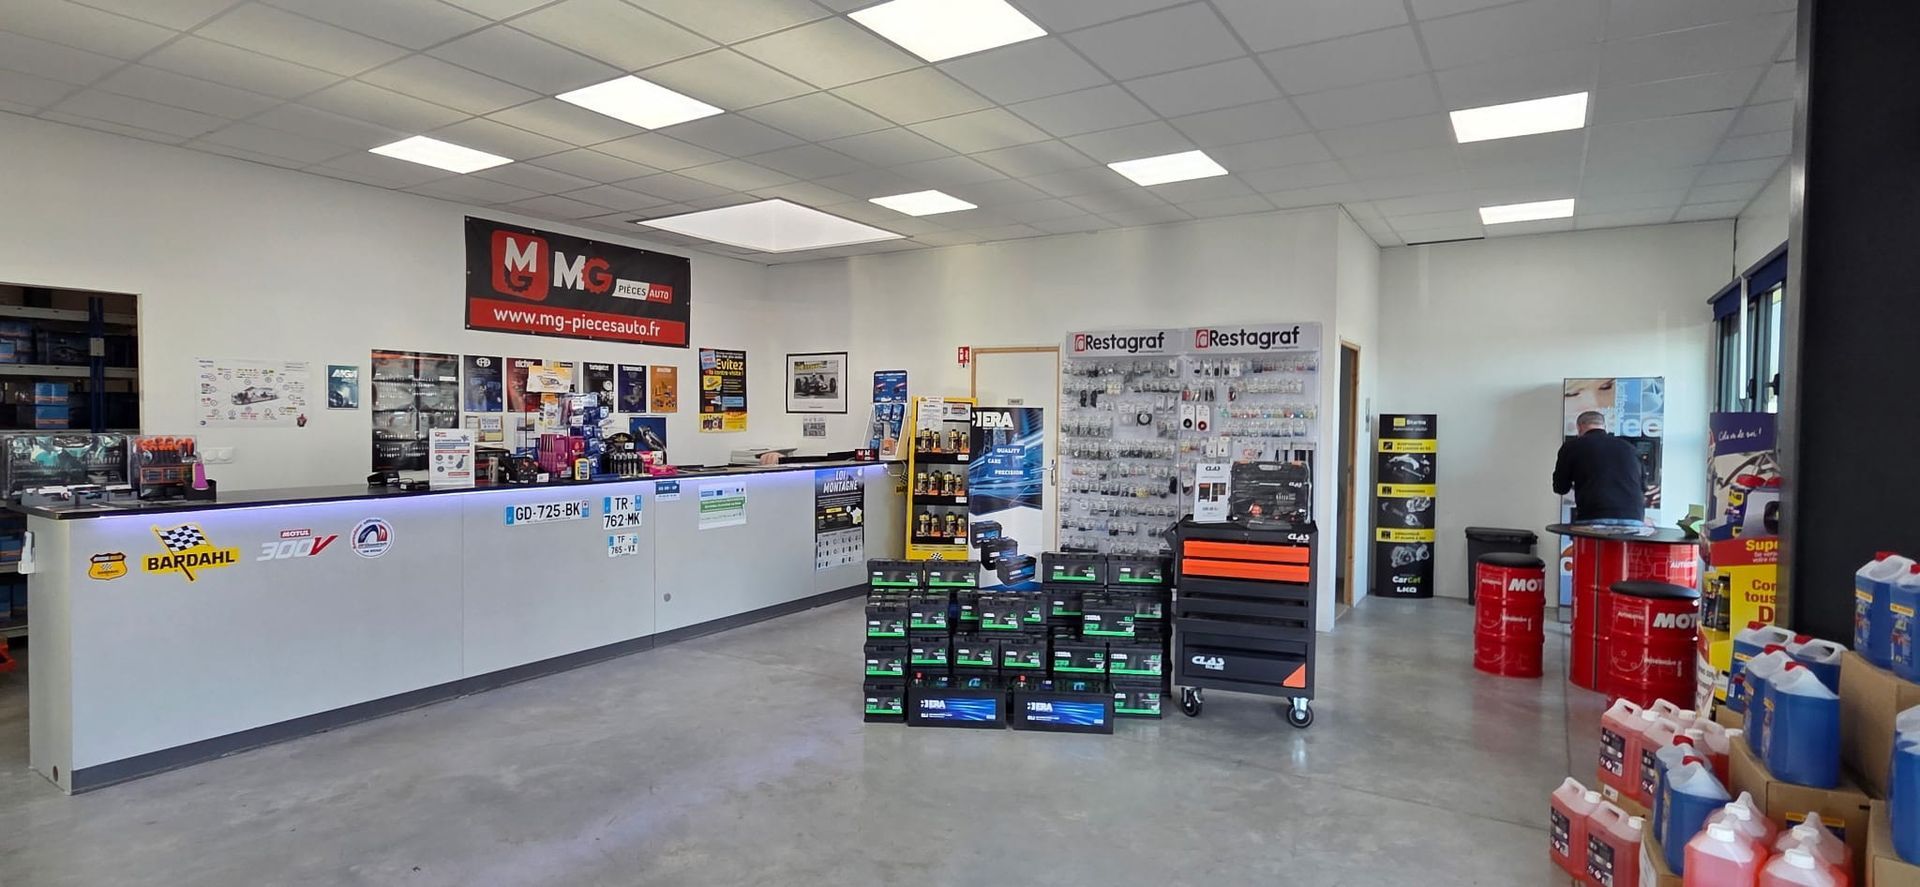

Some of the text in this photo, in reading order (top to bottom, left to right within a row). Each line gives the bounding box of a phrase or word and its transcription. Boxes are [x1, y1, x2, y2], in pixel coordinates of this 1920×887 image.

[649, 287, 669, 300] AUTO
[494, 308, 661, 337] www.mg-piecesauto.fr
[1085, 332, 1165, 353] Restagraf
[1209, 326, 1300, 349] Restagraf
[823, 480, 858, 493] MONTAGNE
[515, 502, 580, 521] GD-725-BK
[282, 530, 310, 538] MOTUL
[1287, 533, 1310, 541] CLAS
[256, 535, 339, 561] 300V
[147, 551, 235, 572] BARDAHL
[1396, 586, 1417, 594] LKQ
[1191, 655, 1225, 667] CLAS
